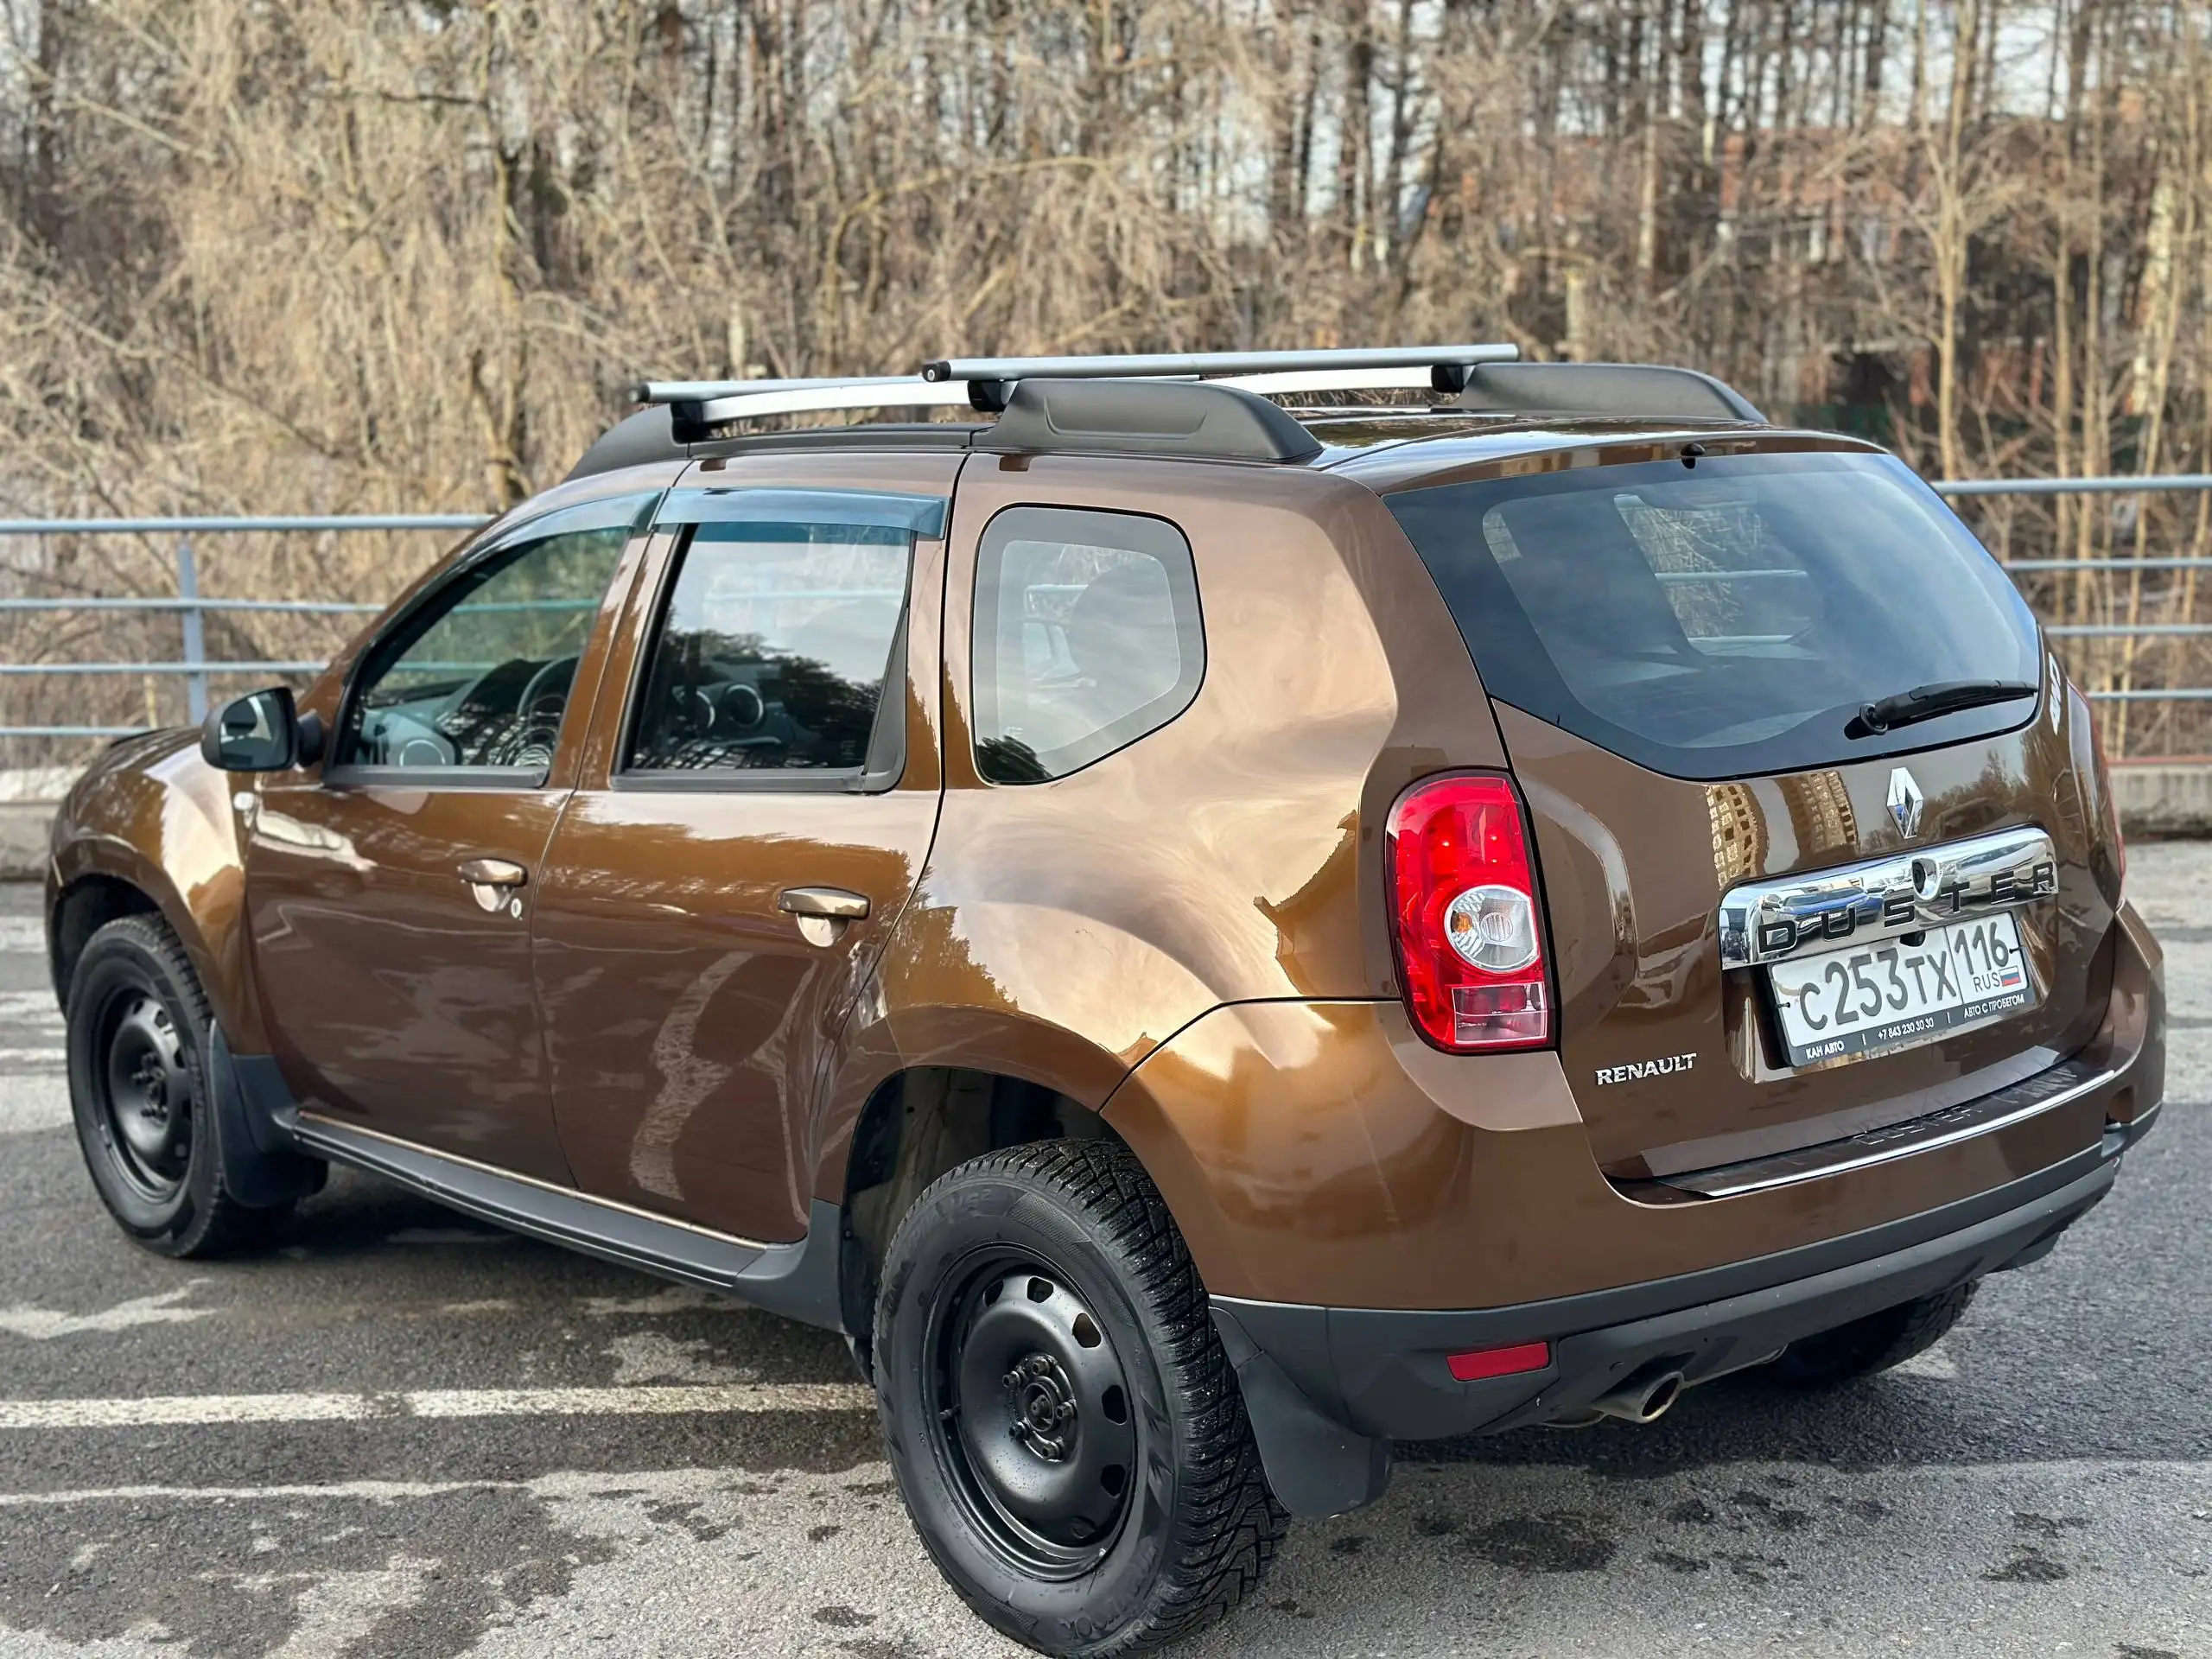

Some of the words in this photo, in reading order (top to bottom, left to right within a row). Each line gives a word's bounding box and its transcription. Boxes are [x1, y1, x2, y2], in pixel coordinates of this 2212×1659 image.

[1758, 862, 2059, 955] DUSTER
[1954, 921, 2010, 976] 116
[1973, 971, 2000, 994] RUS
[1805, 1045, 1823, 1060] КАН
[1824, 1040, 1845, 1055] АВТО
[1878, 1029, 1888, 1041] +7
[1888, 1026, 1902, 1038] 843
[1902, 1023, 1915, 1035] 230
[1915, 1020, 1924, 1033] 30
[1924, 1019, 1934, 1030] 30
[1963, 1006, 1981, 1019] АВТО
[1987, 994, 2025, 1014] ПРОБЕГОМ
[1594, 1052, 1697, 1085] RENAULT
